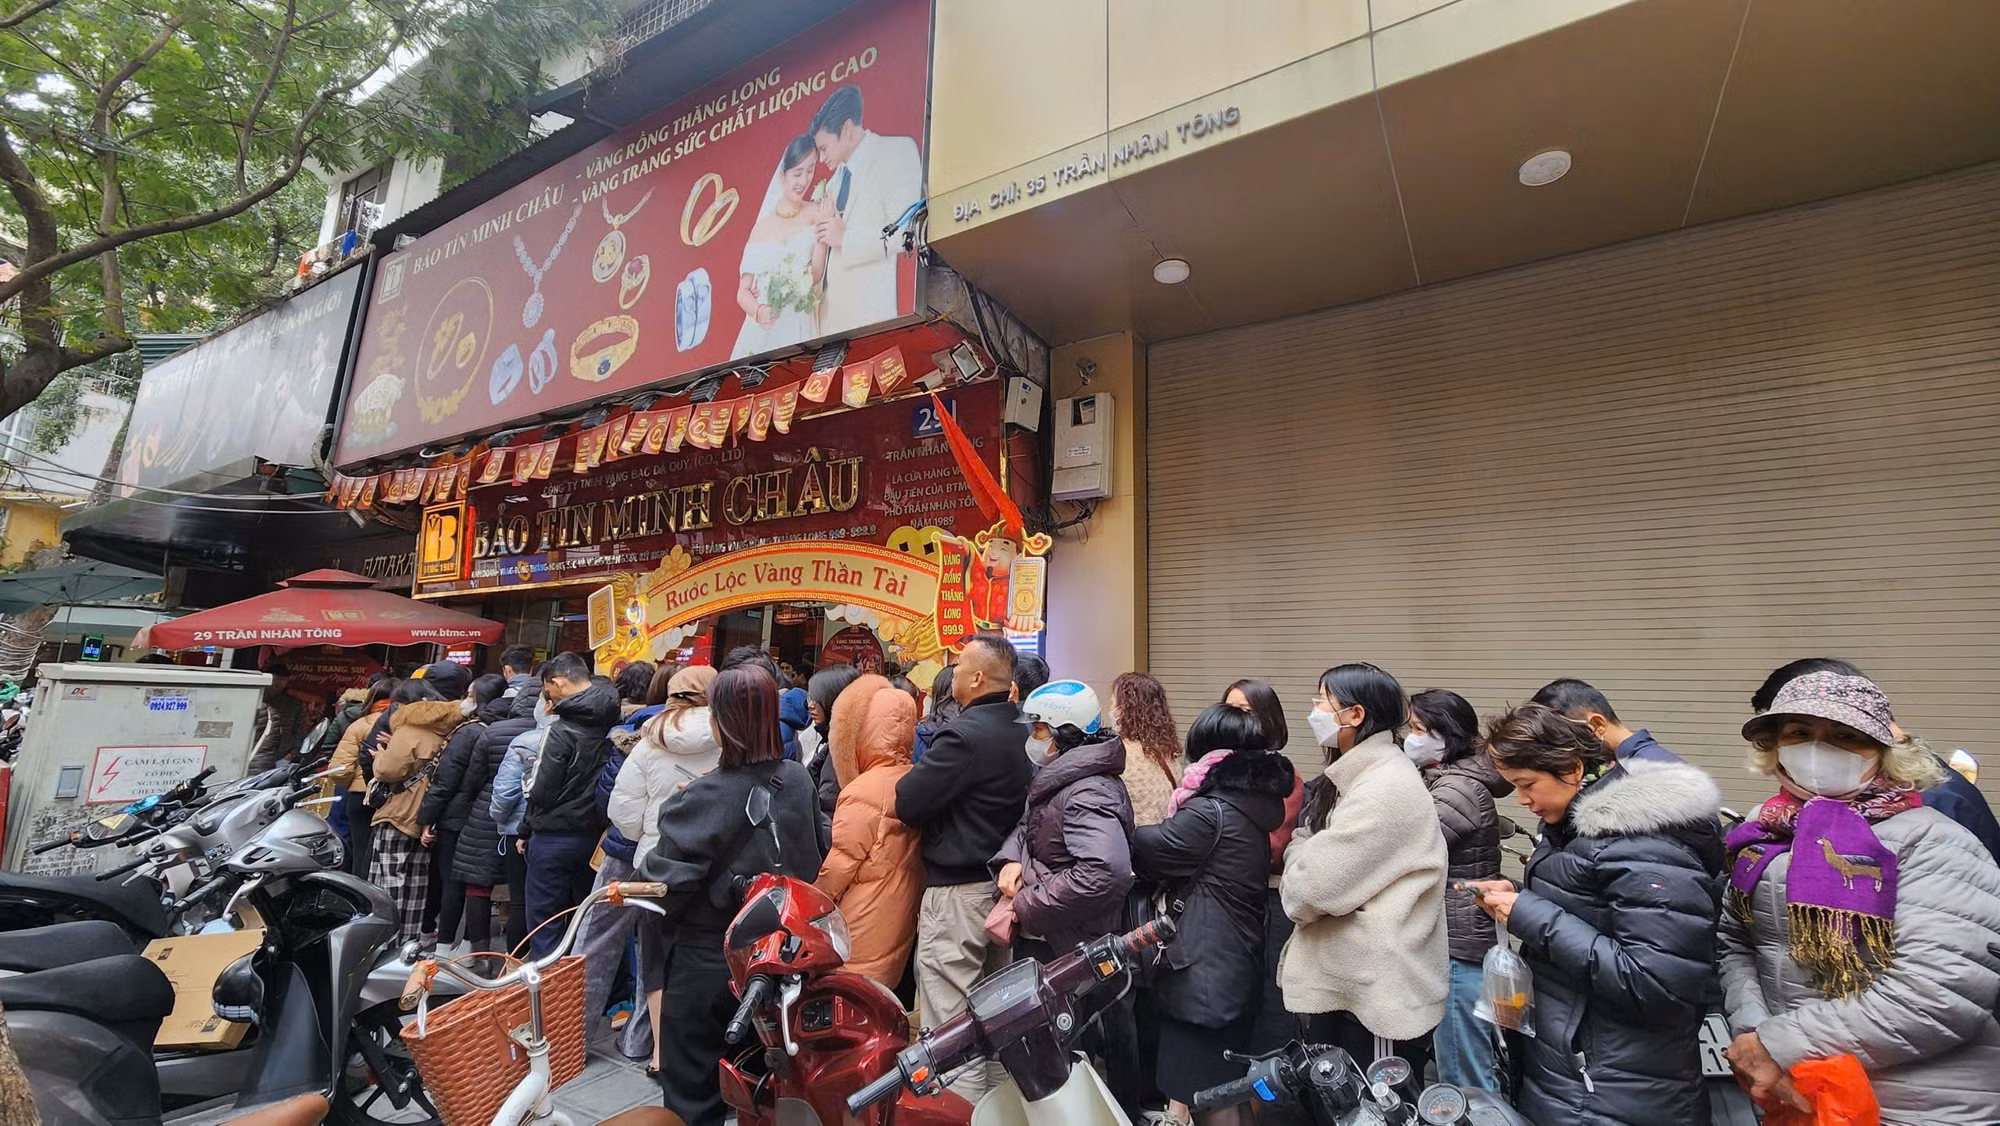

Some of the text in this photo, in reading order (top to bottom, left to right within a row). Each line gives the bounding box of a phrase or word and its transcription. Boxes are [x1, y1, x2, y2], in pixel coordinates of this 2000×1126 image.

[582, 173, 619, 204] VÀNG
[622, 148, 671, 184] TRANG
[674, 131, 707, 160] SỨC
[709, 104, 757, 142] CHẤT
[758, 71, 826, 121] LƯỢNG
[830, 46, 879, 83] CAO
[586, 149, 623, 179] VÀNG
[625, 125, 669, 160] RỒNG
[673, 95, 726, 136] THĂNG
[731, 66, 781, 107] LONG
[953, 201, 981, 222] ĐỊA
[1026, 175, 1048, 196] 35
[1053, 153, 1107, 186] TRẦN
[1111, 129, 1169, 168] NHÂN
[1176, 105, 1240, 144] TÔNG
[444, 233, 468, 260] TÍN
[469, 210, 513, 247] MINH
[515, 184, 565, 224] CHÂU
[543, 482, 566, 496] CÔNG
[568, 481, 578, 492] TY
[472, 503, 529, 558] BẢO
[600, 481, 716, 543] MINH
[722, 447, 864, 527] CHÂU
[958, 495, 978, 508] TÔN
[934, 515, 954, 526] 1989
[666, 559, 908, 612] Rước Lộc Vàng Thần Tài
[943, 607, 962, 619] LONG
[193, 627, 342, 641] 29 TRẦN NHÂN TÔNG
[411, 627, 481, 637] www.btmc.vn
[942, 624, 965, 636] 999.9
